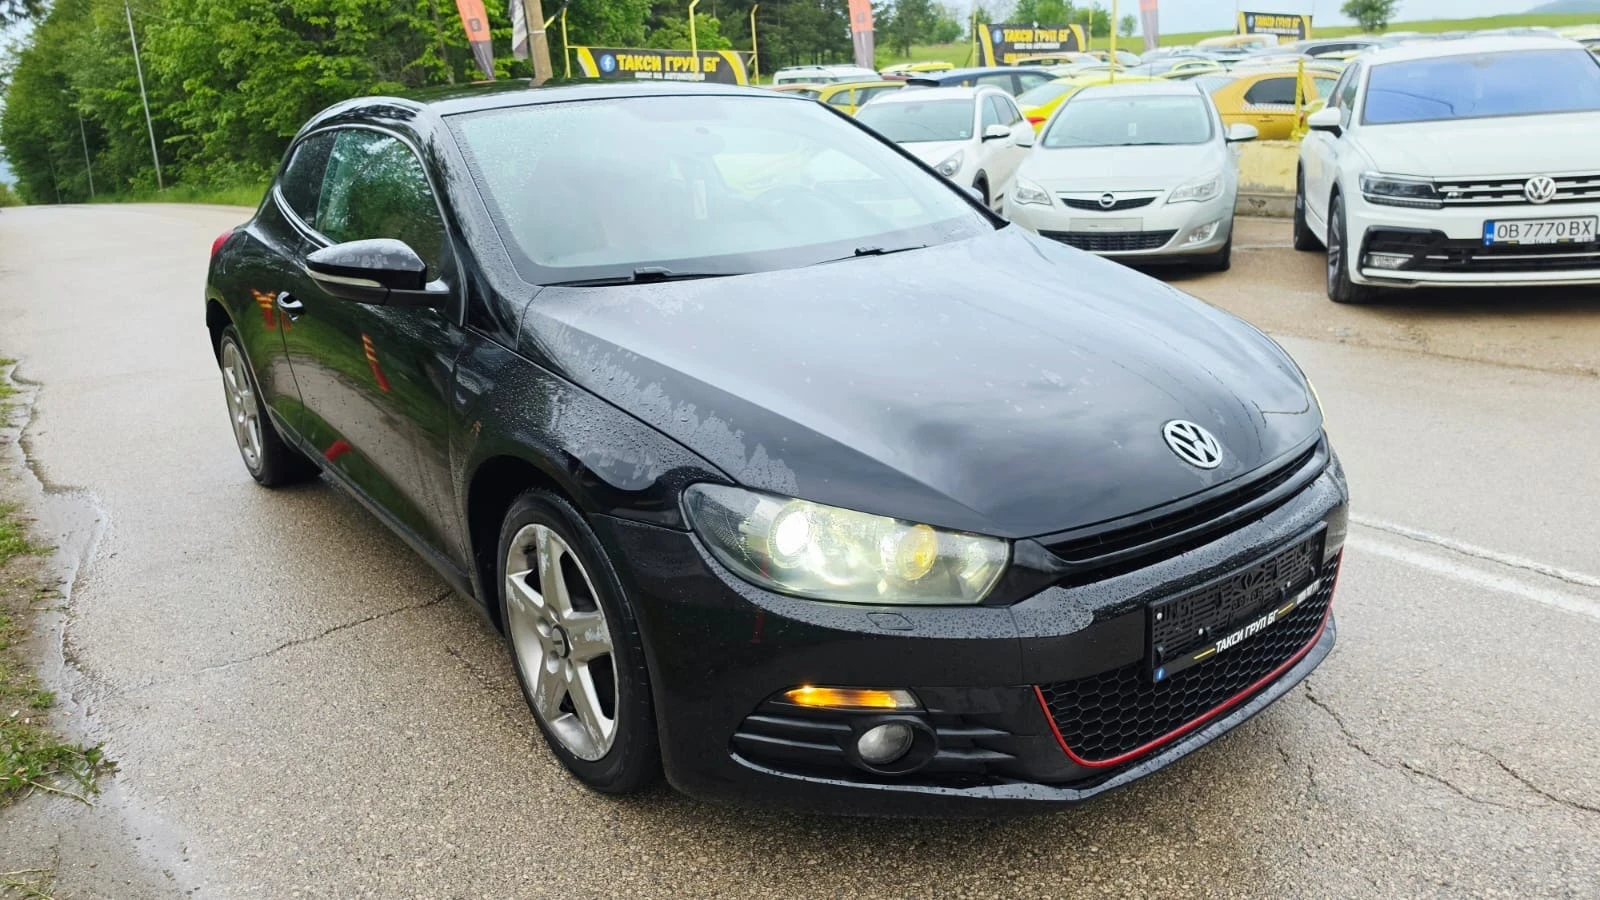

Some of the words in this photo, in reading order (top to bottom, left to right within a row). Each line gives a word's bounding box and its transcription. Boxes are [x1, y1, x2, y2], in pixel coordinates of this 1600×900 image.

[616, 54, 661, 71] ТАКСИ
[703, 57, 720, 72] БГ
[1497, 224, 1519, 239] OB
[1523, 222, 1566, 239] 7770
[1569, 220, 1592, 237] BX
[1215, 631, 1244, 654] ТАКСИ
[1244, 618, 1267, 640] ГРУП
[1267, 608, 1279, 625] БГ
